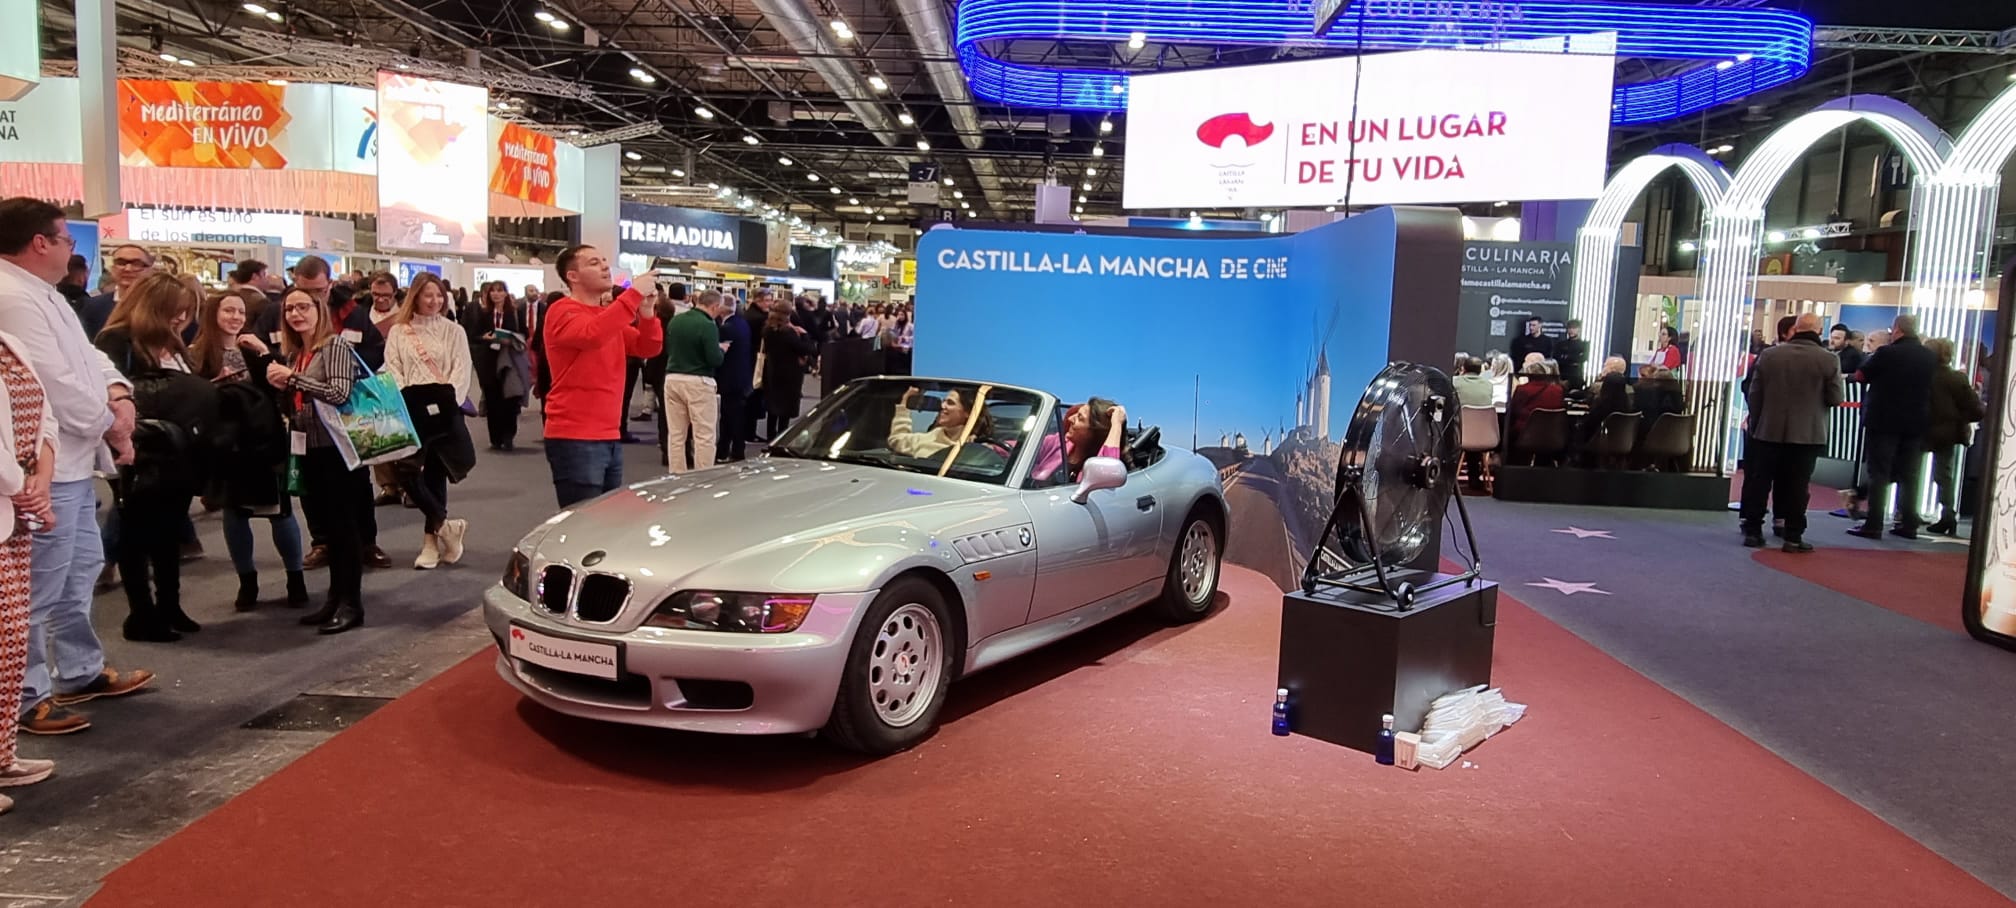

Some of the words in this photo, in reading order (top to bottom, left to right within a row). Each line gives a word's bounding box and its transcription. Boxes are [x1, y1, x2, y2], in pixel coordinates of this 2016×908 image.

[141, 100, 263, 123] Mediterráneo
[192, 127, 214, 144] EN
[1301, 121, 1338, 146] EN
[1348, 118, 1388, 143] UN
[1398, 111, 1507, 141] LUGAR
[1299, 160, 1335, 184] DE
[1344, 158, 1382, 182] TU
[1392, 154, 1465, 180] VIDA
[141, 228, 160, 241] de
[165, 229, 189, 242] los
[620, 220, 734, 250] TREMADURA
[937, 248, 1093, 275] CASTILLA-LA
[1100, 256, 1210, 279] MANCHA
[1220, 258, 1249, 279] DE
[1253, 256, 1288, 279] CINE
[1465, 247, 1572, 267] CULINARIA
[1496, 265, 1508, 273] LA
[1510, 266, 1545, 275] MANCHA
[528, 642, 573, 660] CASTILLA-LA
[574, 652, 614, 666] MANCHA
